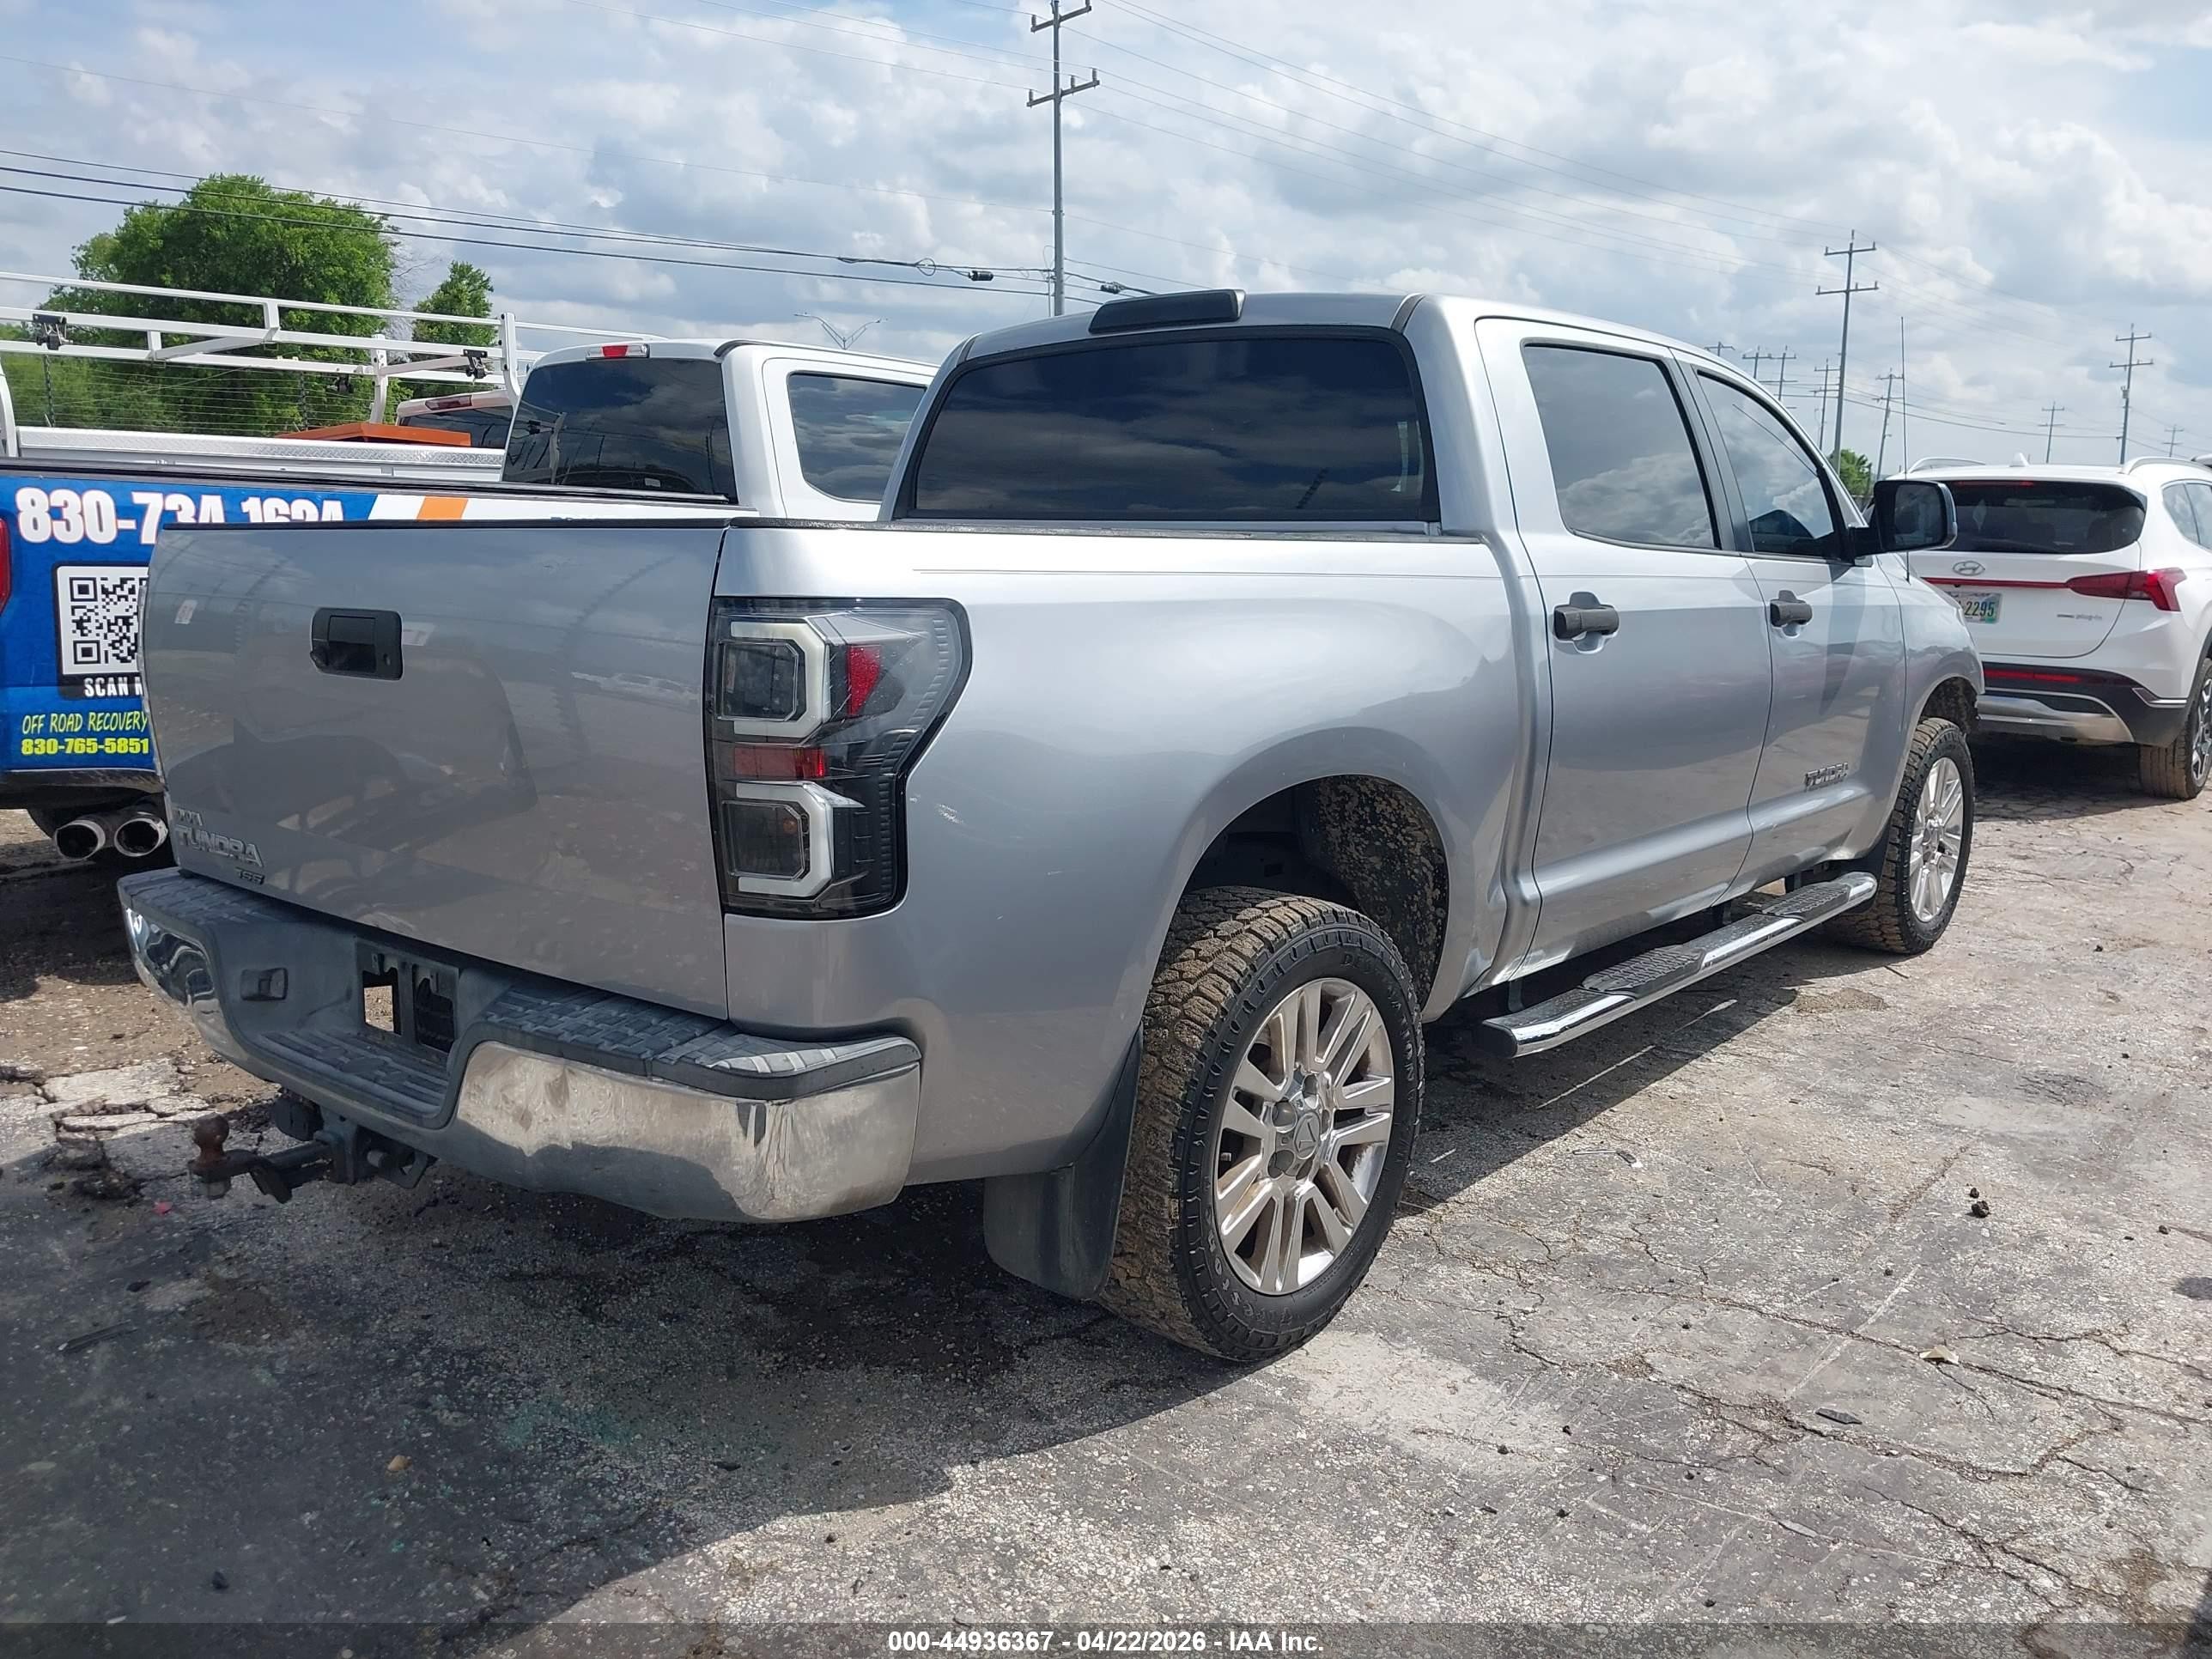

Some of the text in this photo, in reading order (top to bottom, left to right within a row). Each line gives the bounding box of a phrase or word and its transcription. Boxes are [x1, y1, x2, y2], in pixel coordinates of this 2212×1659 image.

[84, 677, 129, 697] SCAN
[22, 710, 149, 735] OFF ROAD RECOVERY
[21, 738, 149, 756] 830-765-5851
[174, 825, 263, 866] TUNDRA
